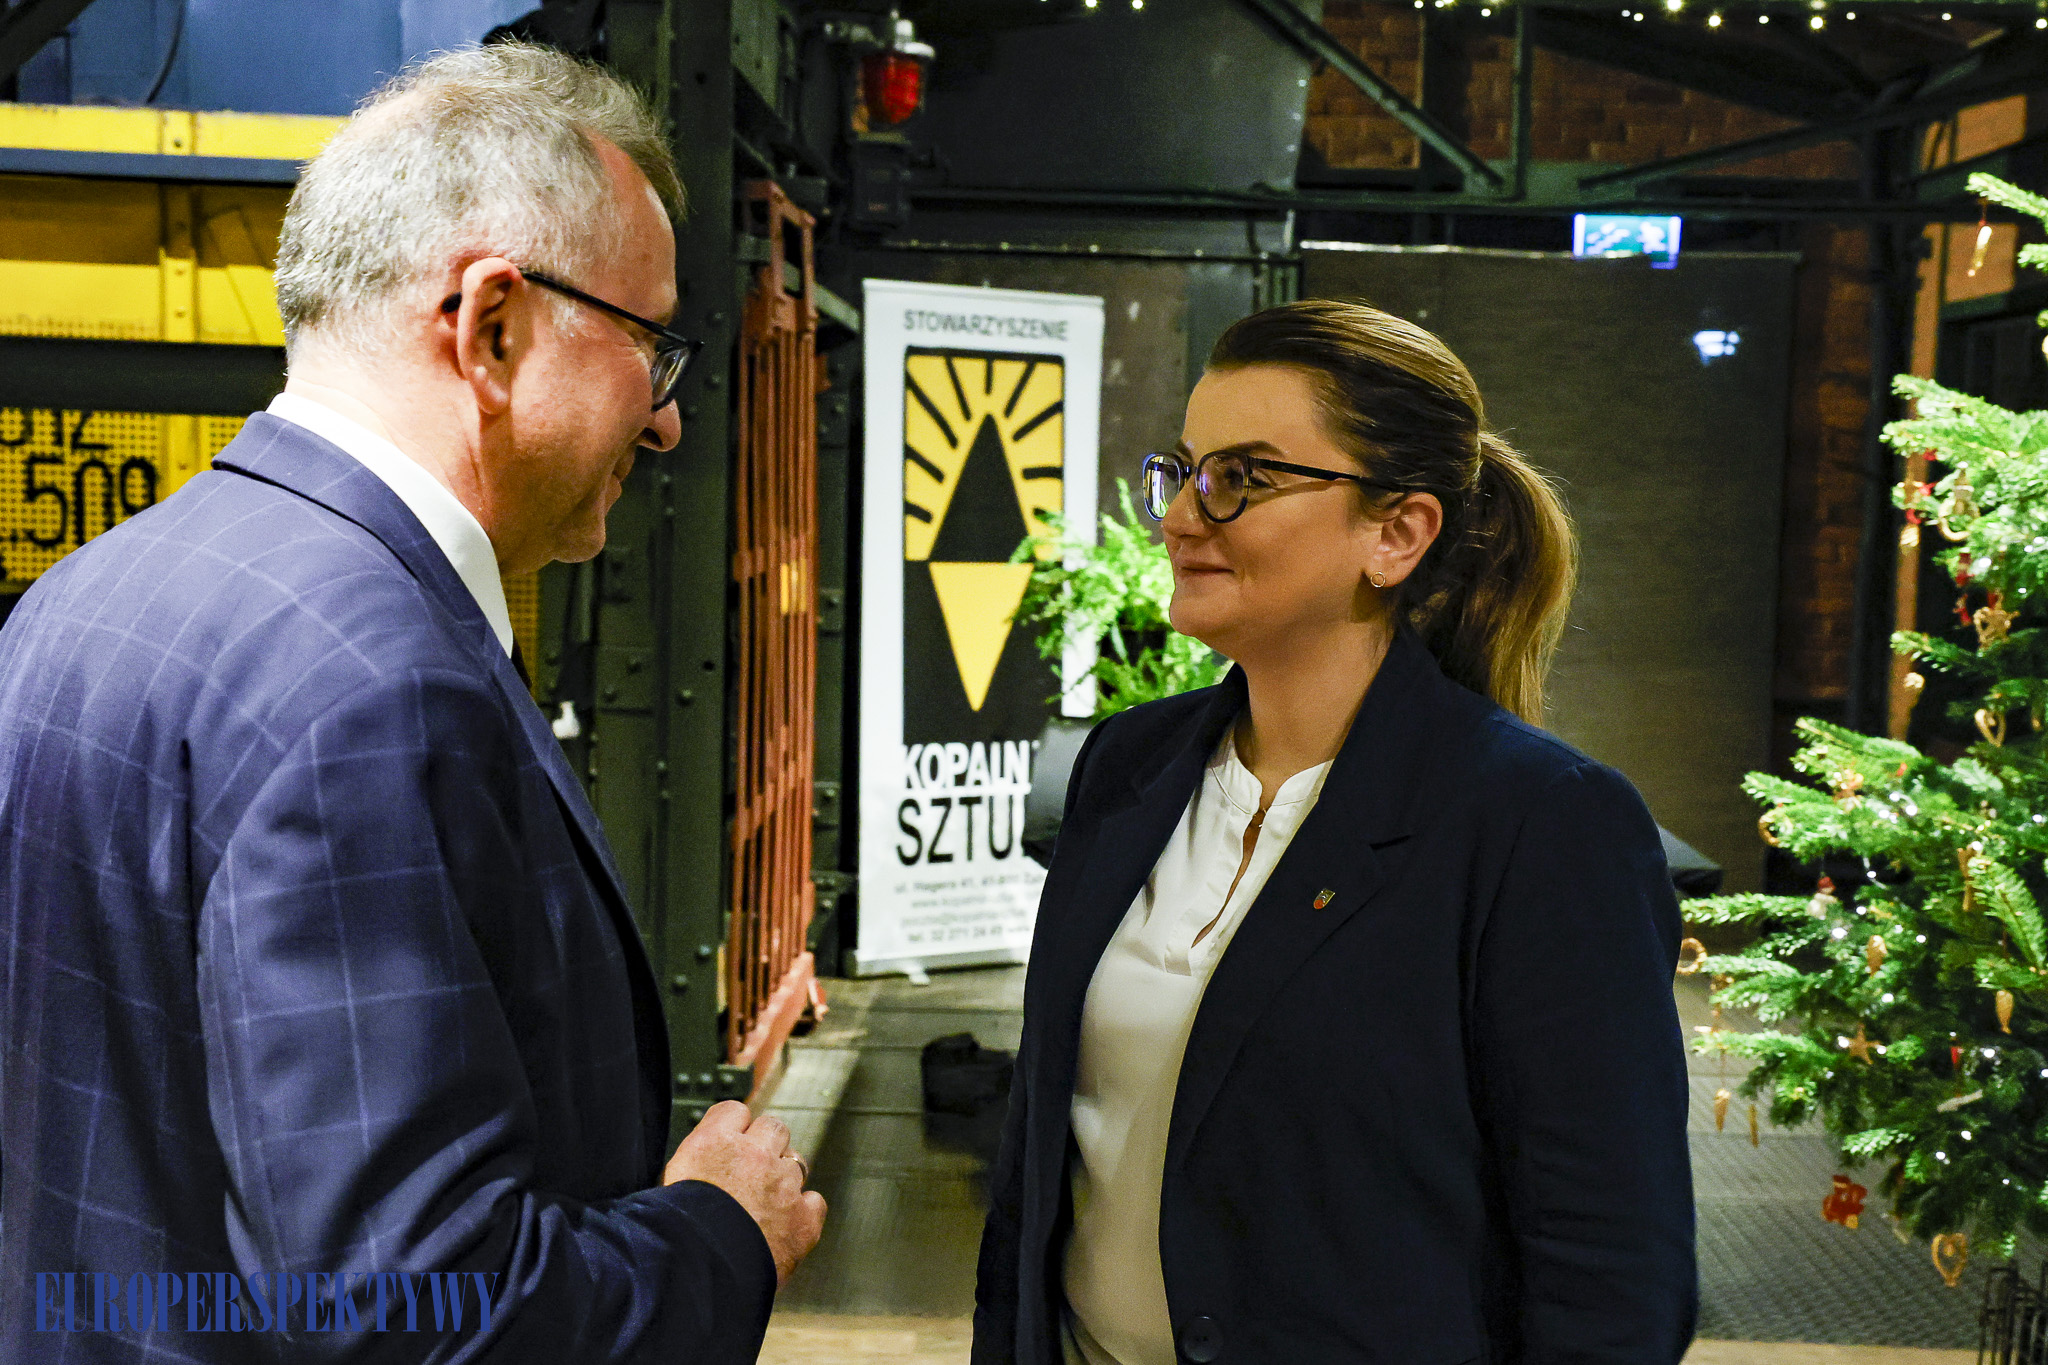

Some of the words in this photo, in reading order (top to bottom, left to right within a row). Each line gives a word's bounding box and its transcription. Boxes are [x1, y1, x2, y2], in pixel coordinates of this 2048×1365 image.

[904, 309, 1068, 341] STOWARZYSZENIE
[901, 740, 1040, 789] KOPALN
[895, 796, 1015, 866] SZTU
